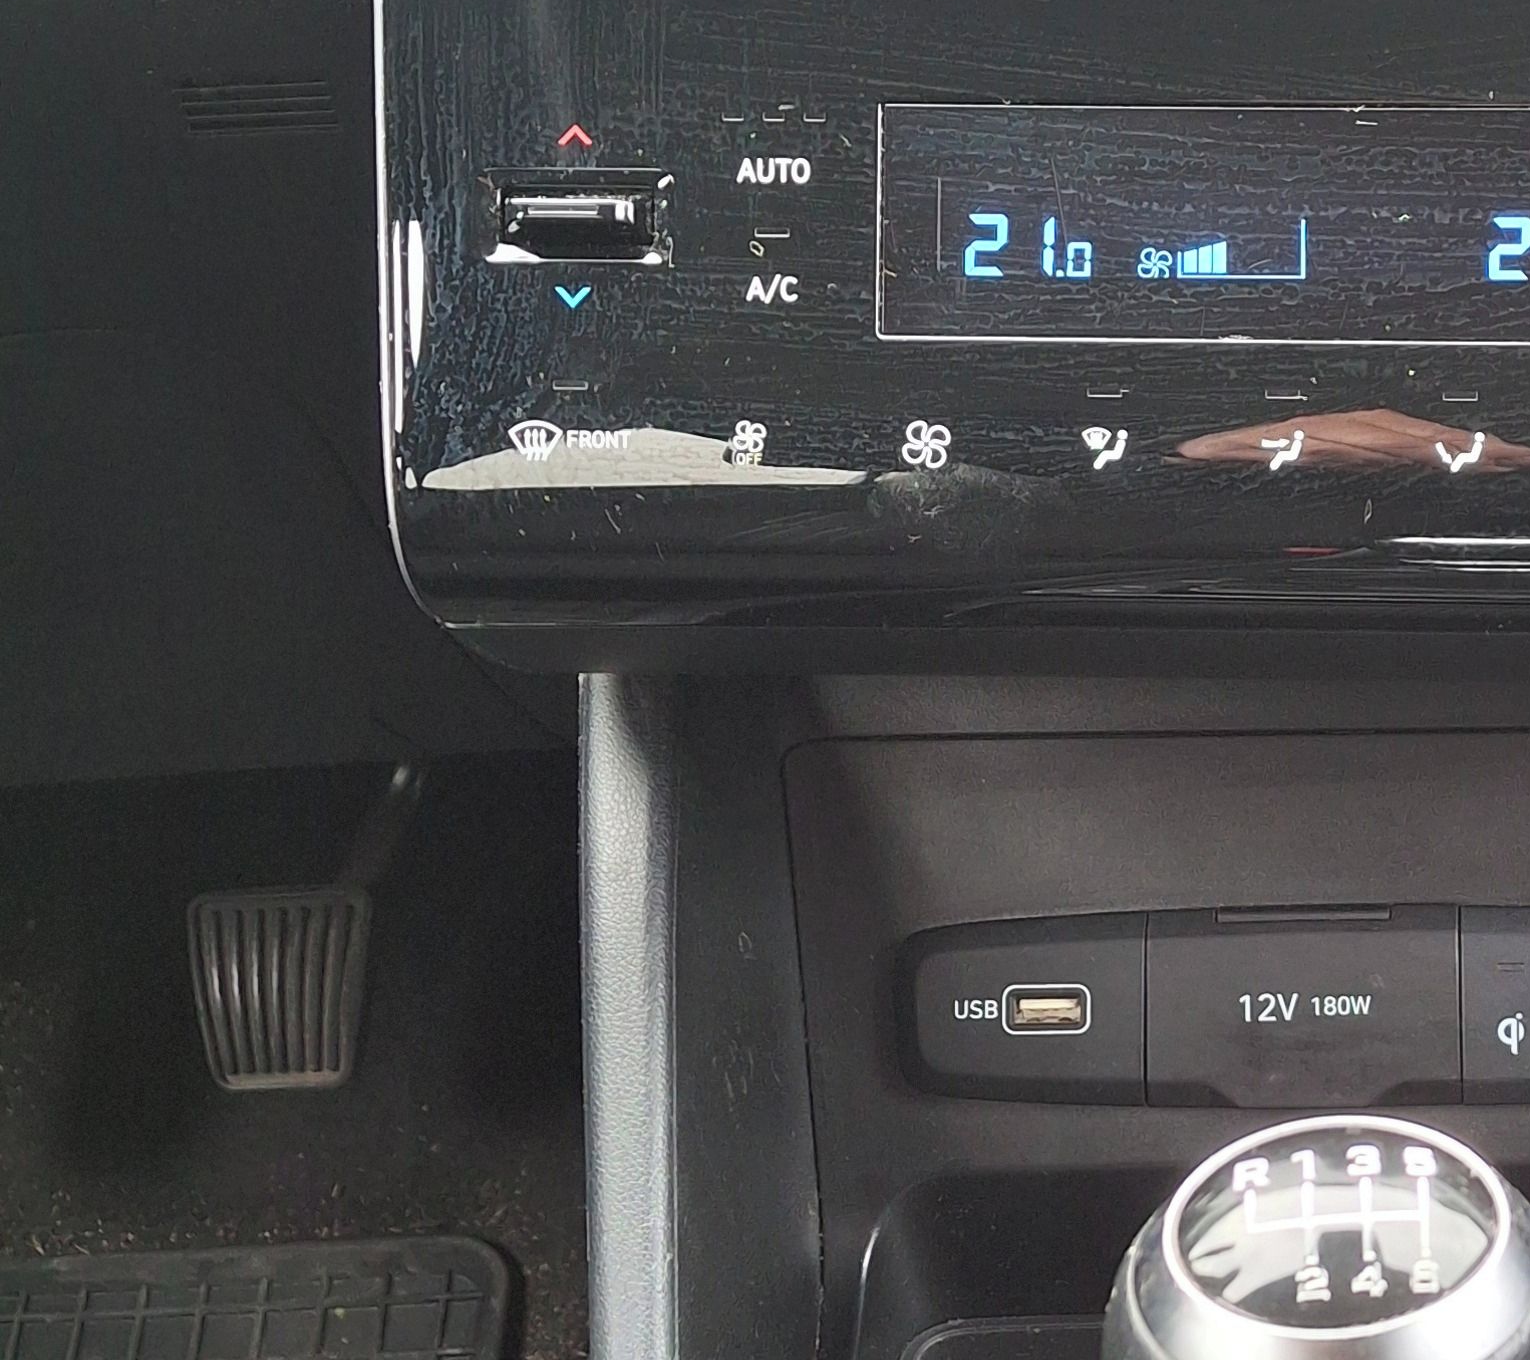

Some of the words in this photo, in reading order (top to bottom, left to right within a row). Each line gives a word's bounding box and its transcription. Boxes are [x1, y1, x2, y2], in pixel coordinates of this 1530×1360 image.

[736, 158, 812, 185] AUTO
[963, 213, 1092, 278] 21.0
[746, 274, 799, 304] A/C
[566, 430, 632, 449] FRONT
[954, 1000, 999, 1021] USB
[1237, 992, 1297, 1024] 12V
[1310, 996, 1372, 1018] 180W
[1231, 1156, 1269, 1192] R
[1291, 1149, 1316, 1181] 1
[1346, 1145, 1382, 1178] 3
[1294, 1265, 1332, 1303] 2
[1351, 1261, 1389, 1298] 4
